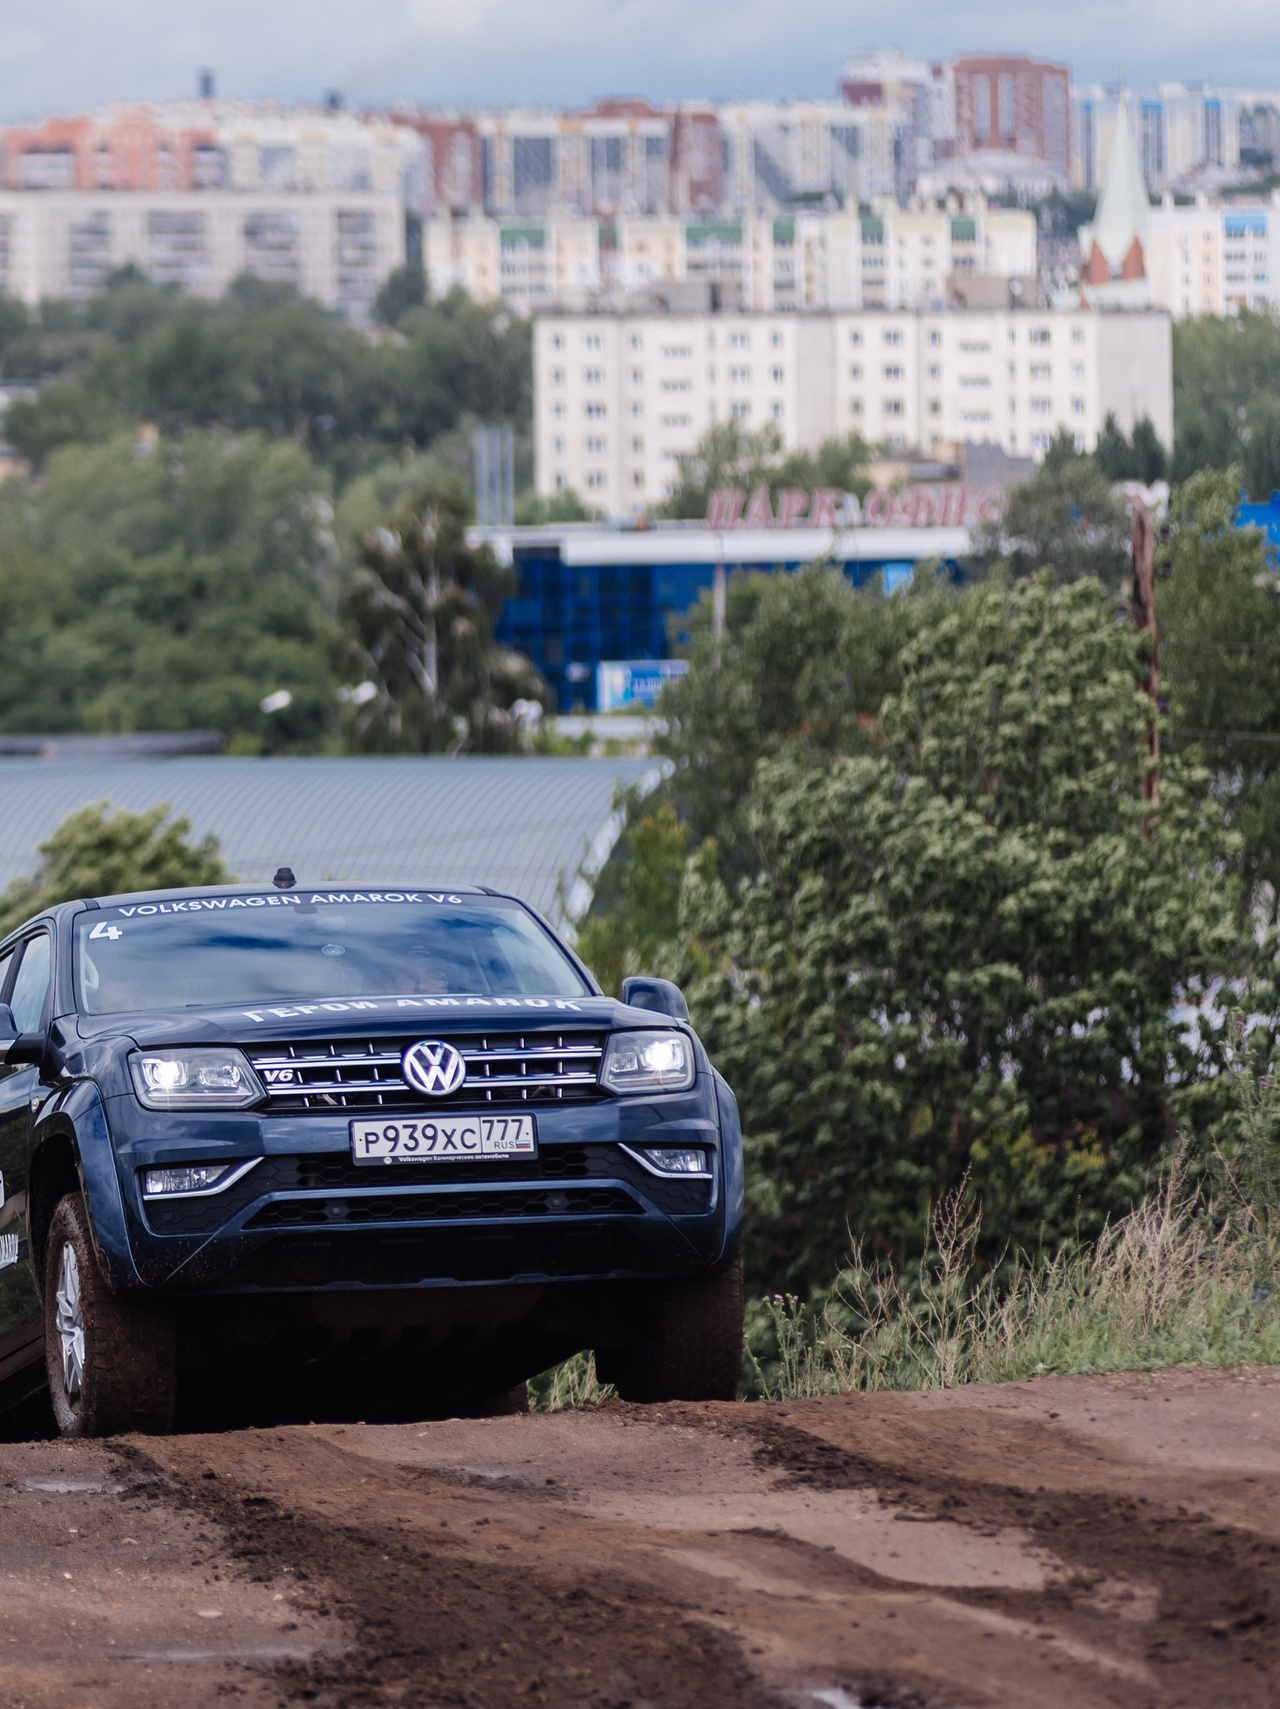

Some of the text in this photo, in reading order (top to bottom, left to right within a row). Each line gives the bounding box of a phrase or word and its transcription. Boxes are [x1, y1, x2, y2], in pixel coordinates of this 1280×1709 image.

[705, 487, 842, 530] ПАРК
[119, 893, 463, 917] VOLKSWAGEN AMAROK V6
[88, 921, 123, 940] 4
[396, 997, 582, 1011] AMAROK
[263, 1068, 294, 1082] V6
[482, 1118, 524, 1141] 777
[494, 1141, 515, 1150] RUS
